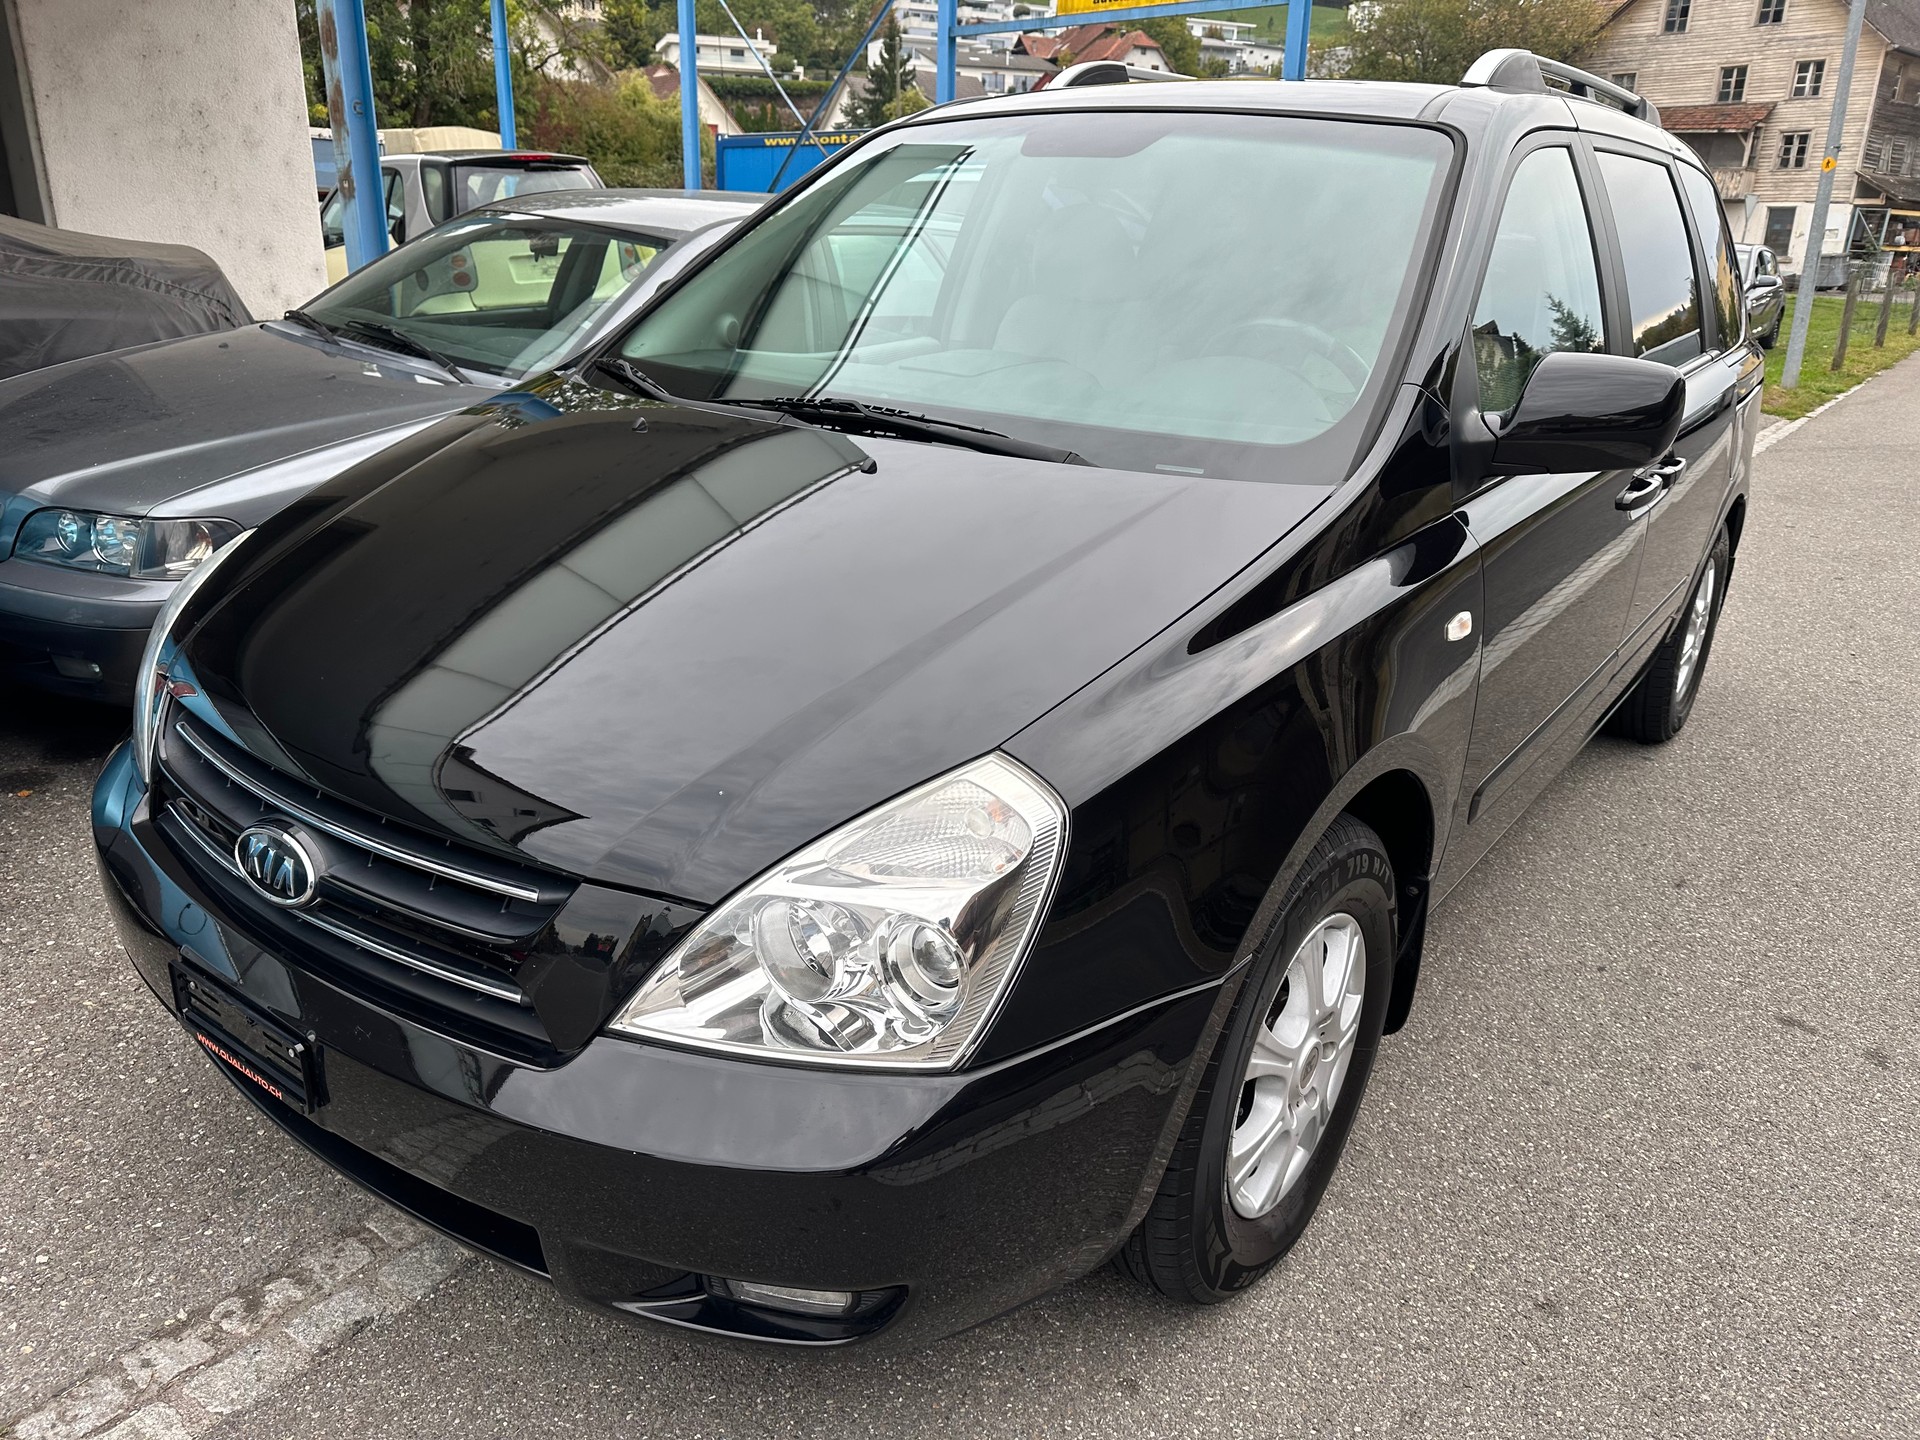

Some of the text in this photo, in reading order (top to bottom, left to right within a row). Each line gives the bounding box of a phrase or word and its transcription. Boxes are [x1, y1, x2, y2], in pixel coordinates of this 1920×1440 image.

[245, 836, 295, 897] KIA
[1347, 853, 1369, 879] 719
[1373, 856, 1390, 884] H/T
[196, 1032, 283, 1100] WWW.QUALIAUTO.CH
